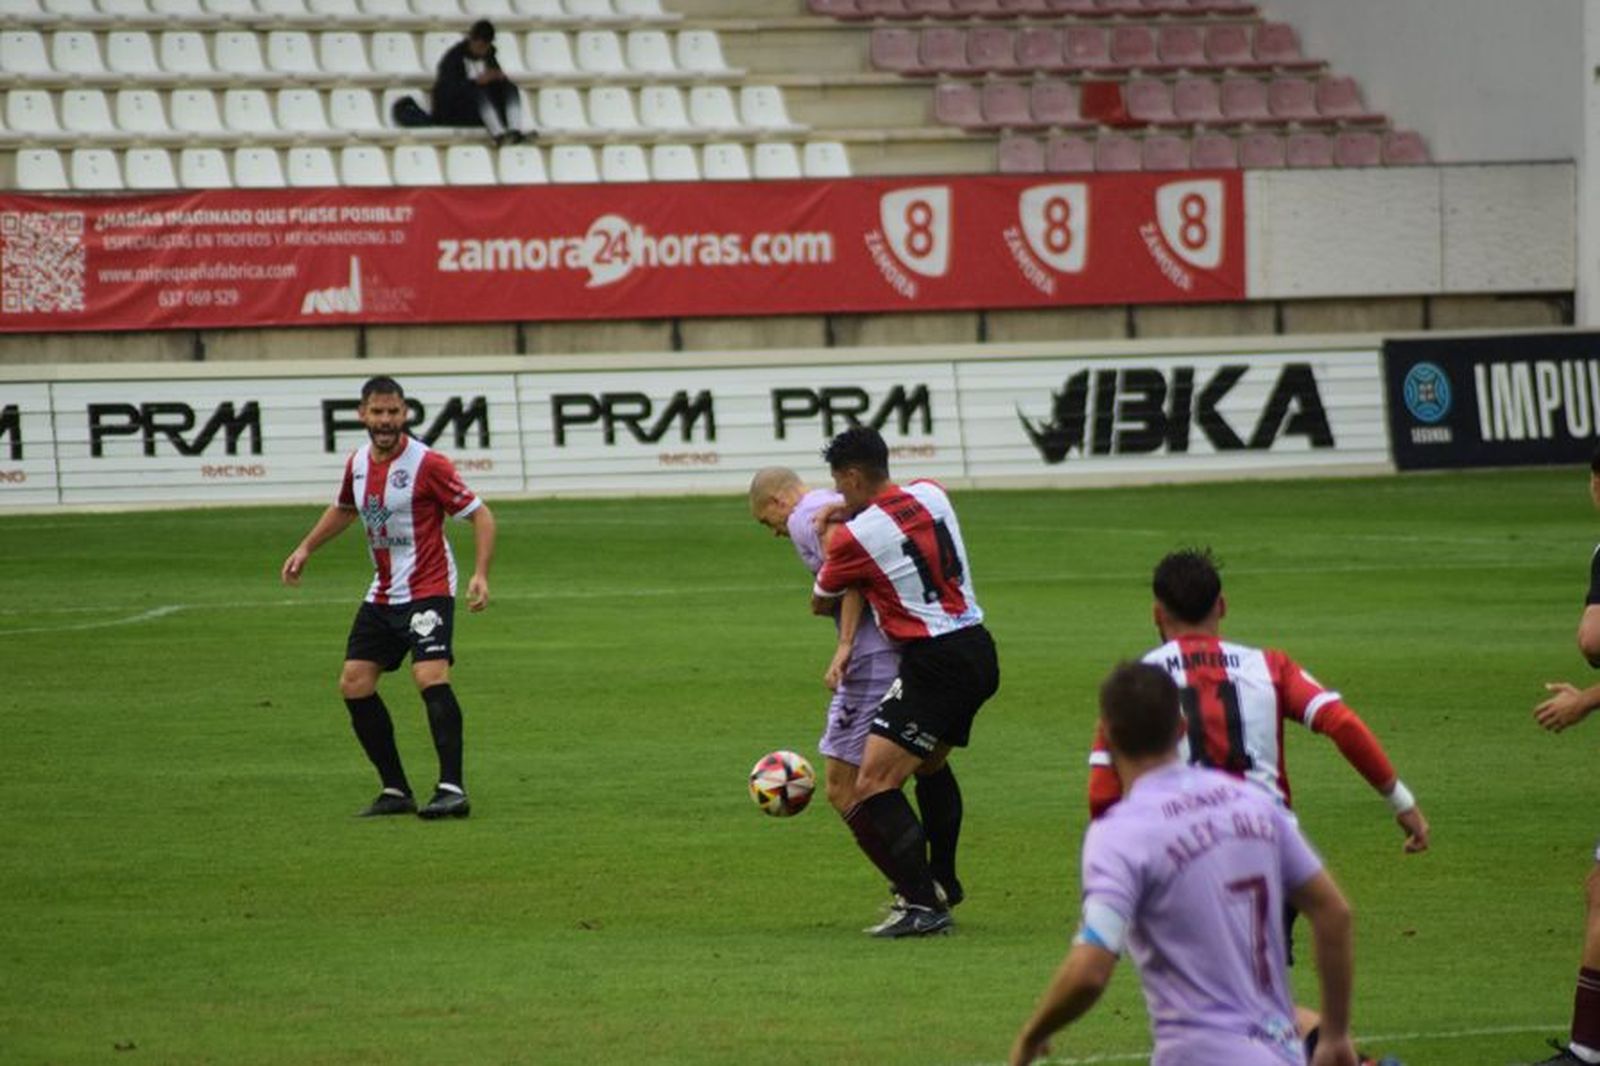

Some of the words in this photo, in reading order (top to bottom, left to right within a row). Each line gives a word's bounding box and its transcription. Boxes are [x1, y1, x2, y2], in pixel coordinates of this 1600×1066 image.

[255, 208, 287, 226] QUE
[289, 207, 338, 223] FUESE
[905, 200, 933, 258] 8
[1043, 196, 1072, 254] 8
[1179, 193, 1207, 250] 8
[864, 229, 919, 299] ZAMORA
[1002, 226, 1058, 296] ZAMORA
[1139, 223, 1192, 293] ZAMORA
[88, 401, 263, 458] PRM
[551, 390, 717, 447] PRM
[1225, 874, 1271, 994] 7
